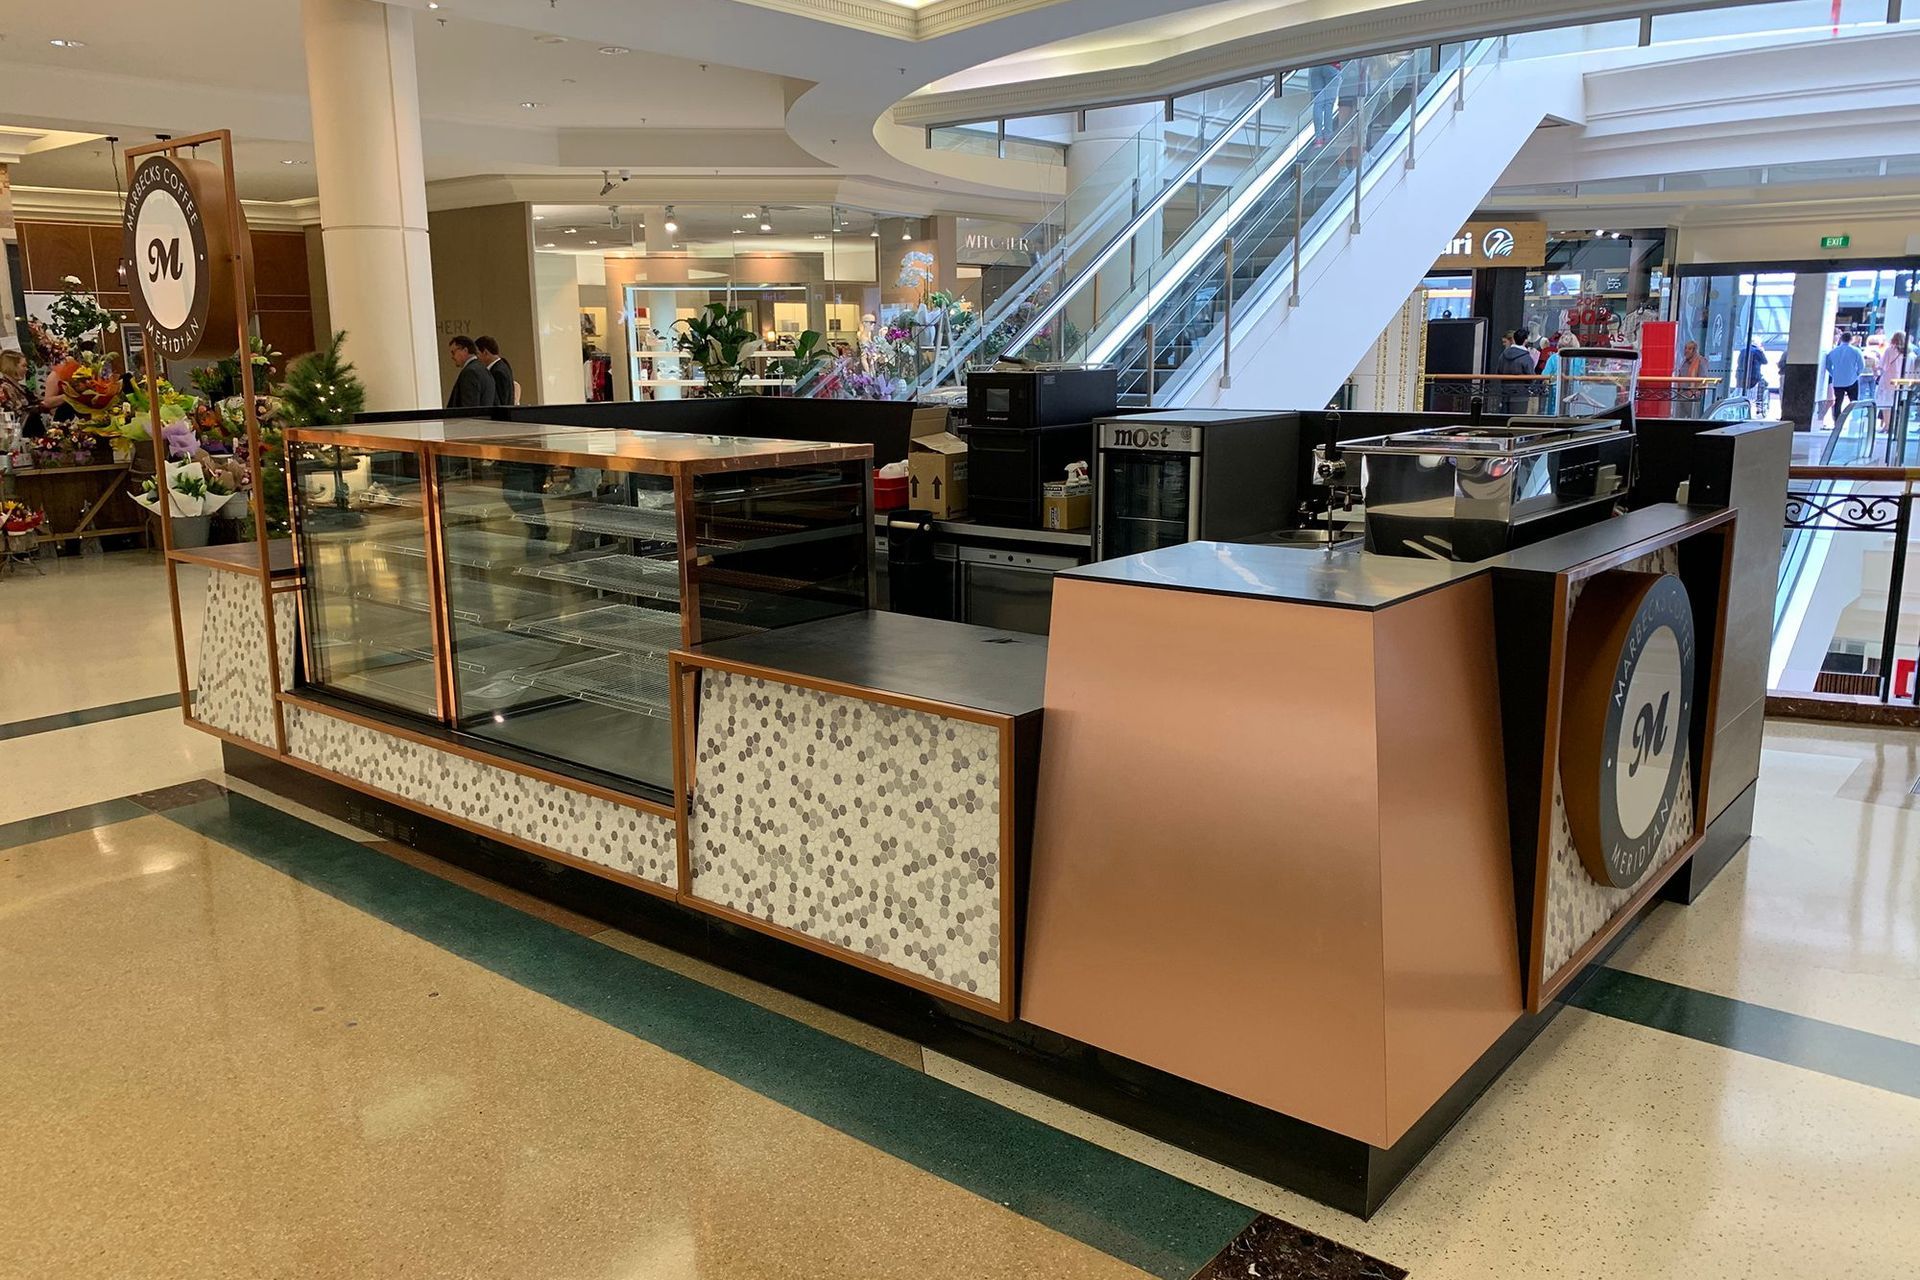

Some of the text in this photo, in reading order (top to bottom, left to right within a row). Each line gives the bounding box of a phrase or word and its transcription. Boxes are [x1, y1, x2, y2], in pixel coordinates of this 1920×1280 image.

[126, 164, 199, 232] MARBECKS COFFEE
[148, 238, 183, 283] M
[1827, 237, 1844, 246] EXIT
[145, 317, 200, 354] MERIDIAN
[1113, 427, 1171, 448] most
[1628, 690, 1670, 779] M
[1610, 797, 1670, 875] MERIDIAN
